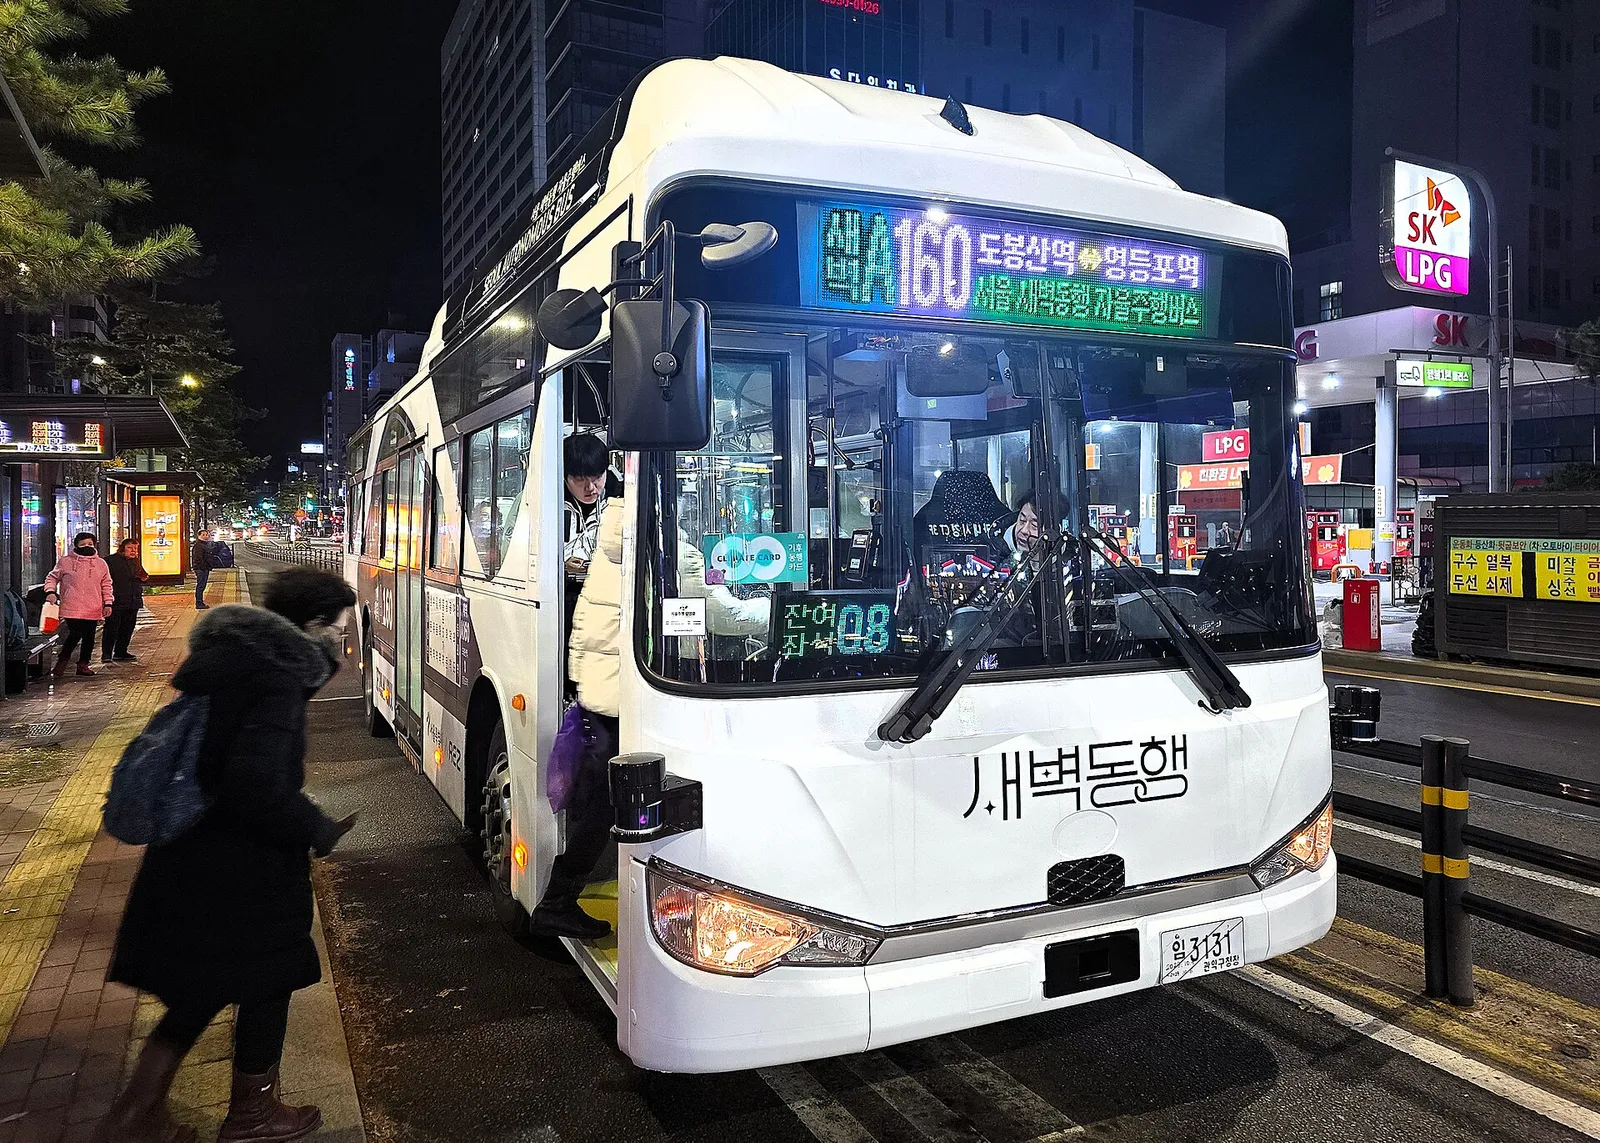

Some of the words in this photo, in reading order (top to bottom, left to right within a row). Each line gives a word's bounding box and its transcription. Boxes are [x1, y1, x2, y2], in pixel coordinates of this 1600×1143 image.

[502, 204, 555, 276] AUTONOMOUS
[553, 183, 576, 224] BUS
[1407, 212, 1437, 246] SK
[977, 232, 1075, 275] 도봉산역
[1104, 245, 1200, 289] 영등포역
[1405, 251, 1452, 290] LPG
[973, 274, 1011, 312] 서울
[1016, 279, 1090, 319] 새벽동행
[1095, 287, 1201, 326] 자율주행버스
[1433, 313, 1470, 348] SK
[1215, 435, 1245, 454] LPG
[1420, 524, 1433, 532] LPG
[716, 554, 755, 563] CLIMATE
[757, 553, 781, 561] CARD
[788, 543, 803, 553] 기후
[788, 553, 803, 562] 동행
[788, 562, 804, 571] 카드
[785, 603, 836, 629] 잔여
[837, 604, 890, 655] 08
[782, 631, 834, 658] 좌석
[963, 734, 1188, 820] 새벽동행
[1190, 930, 1231, 962] 3131
